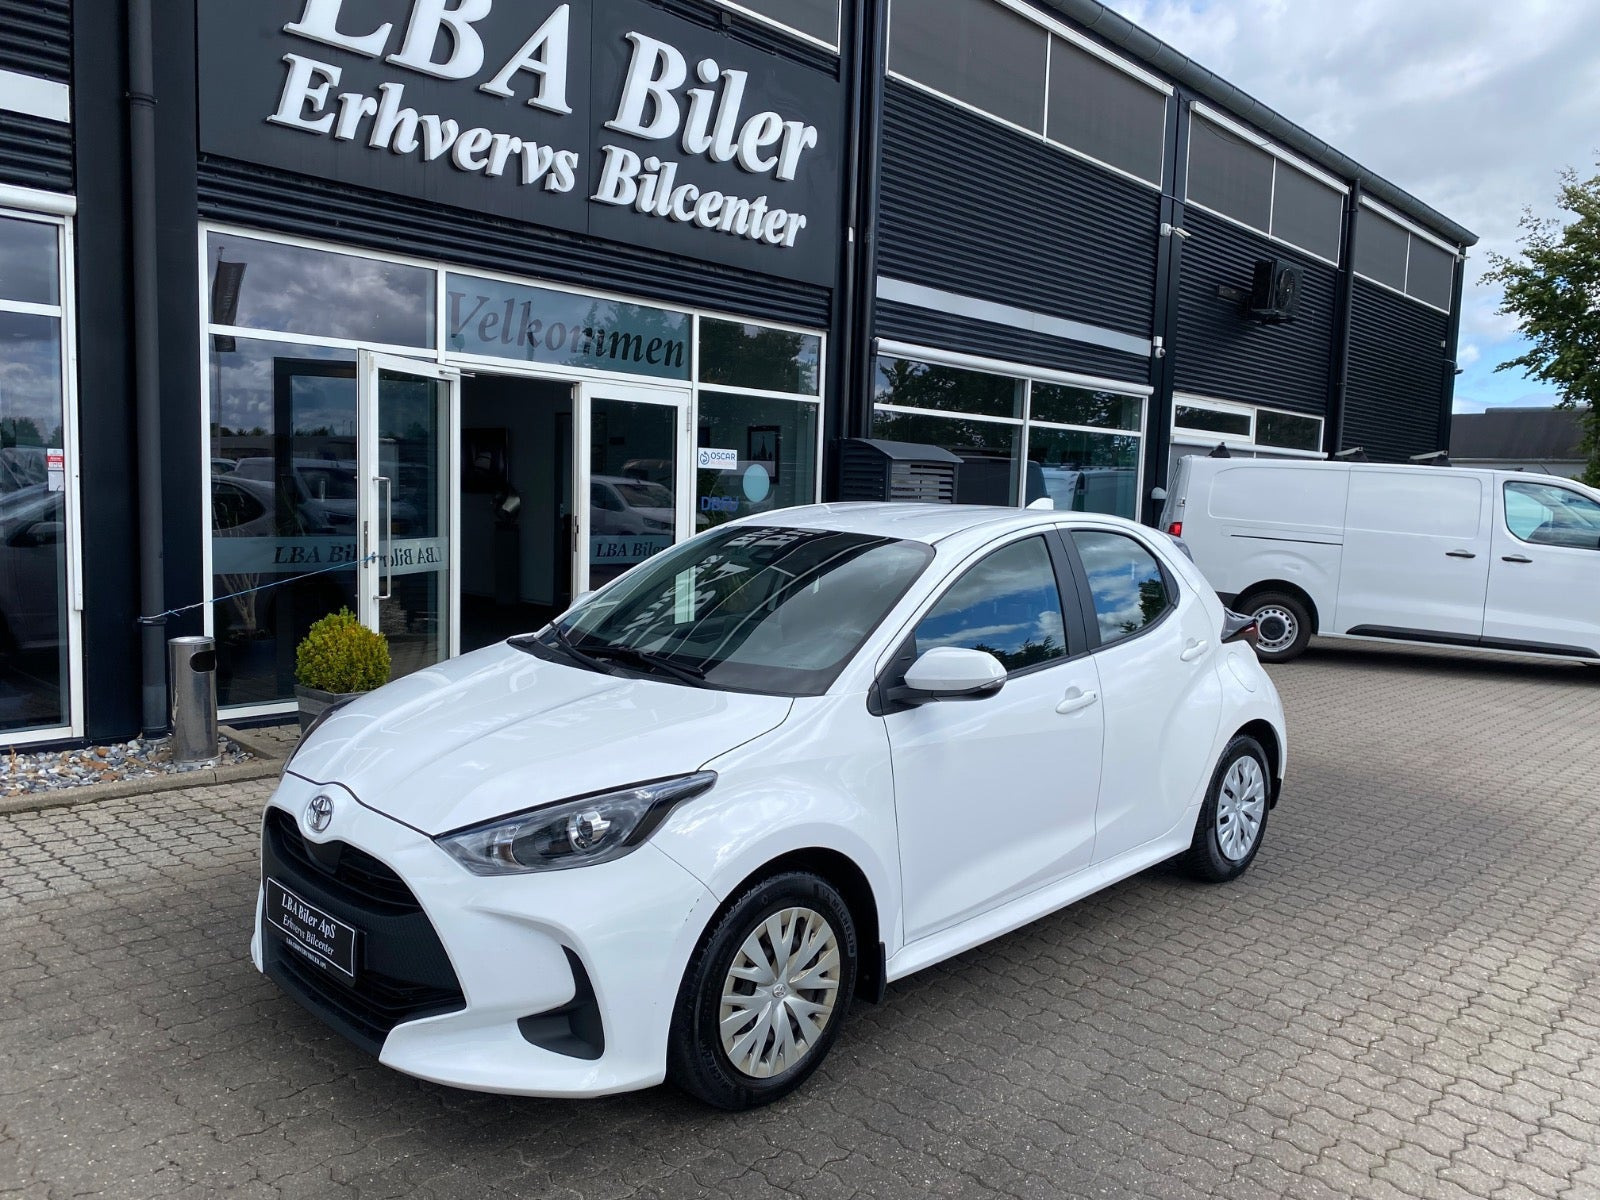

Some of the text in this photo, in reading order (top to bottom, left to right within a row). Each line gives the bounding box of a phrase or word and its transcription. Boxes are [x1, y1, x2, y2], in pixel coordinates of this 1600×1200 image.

[605, 31, 818, 181] Biler
[267, 53, 807, 248] Erhvervs Bilcenter
[447, 290, 684, 368] Velkommen
[710, 451, 736, 461] OSCAR
[272, 543, 357, 564] LBA Bil
[596, 543, 627, 558] LBA
[281, 894, 336, 939] LBA Biler ApS
[305, 931, 334, 955] Bilcenter
